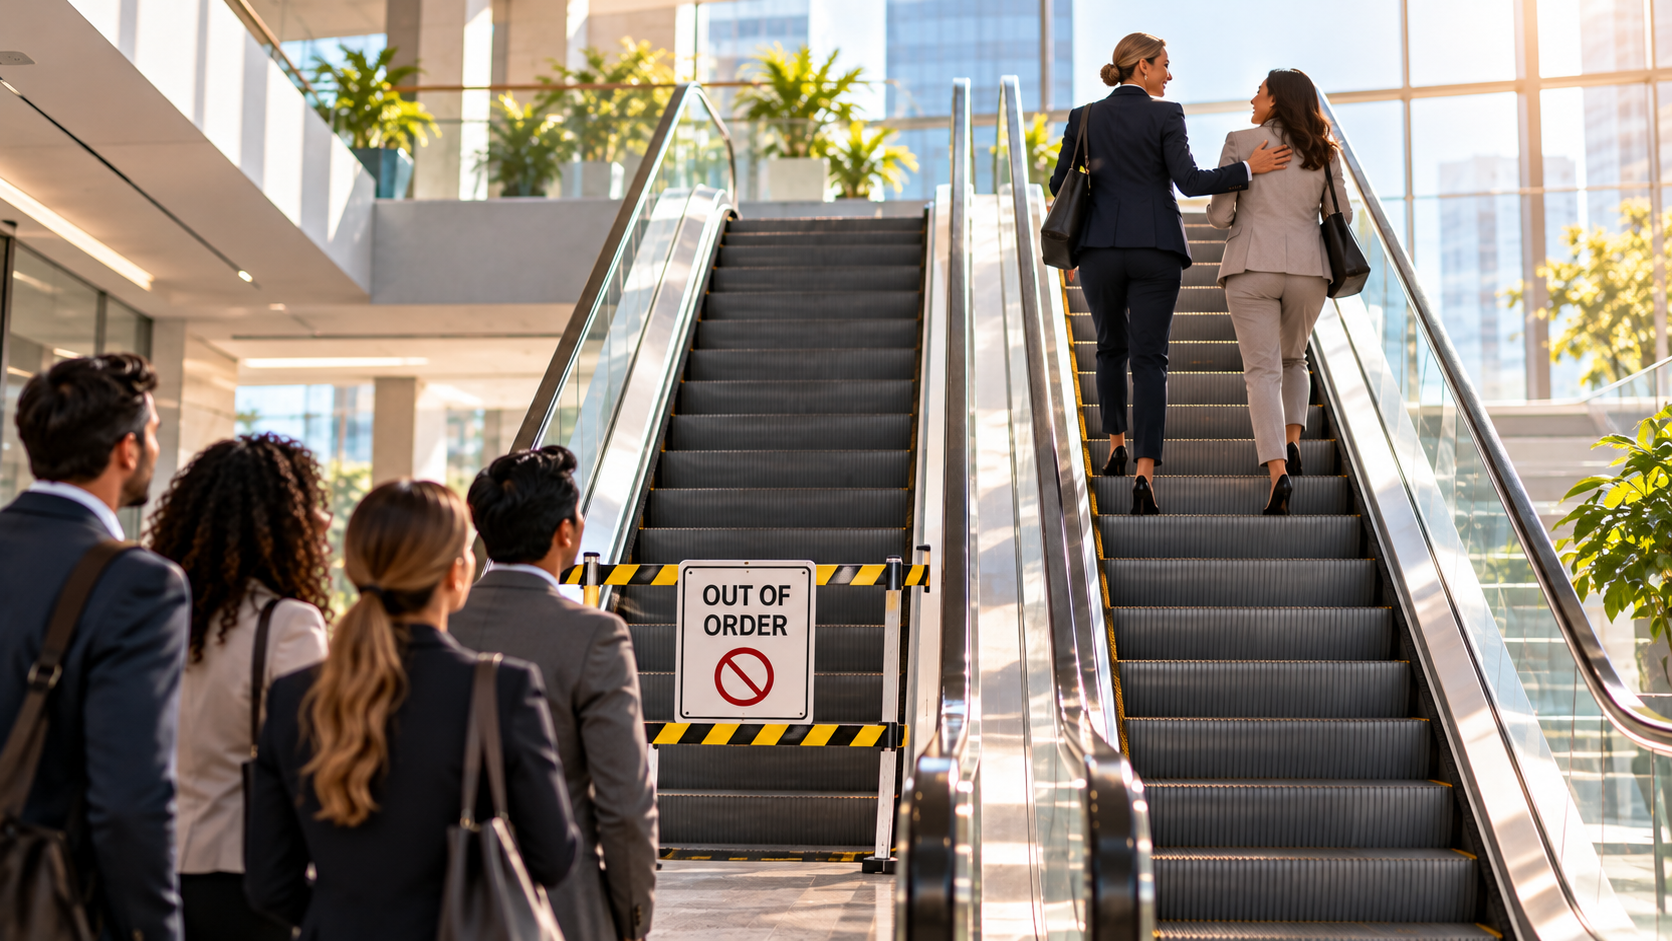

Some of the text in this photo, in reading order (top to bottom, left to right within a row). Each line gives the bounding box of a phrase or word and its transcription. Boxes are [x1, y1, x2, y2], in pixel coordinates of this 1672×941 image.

[703, 584, 791, 606] OUT OF
[704, 614, 788, 636] ORDER
